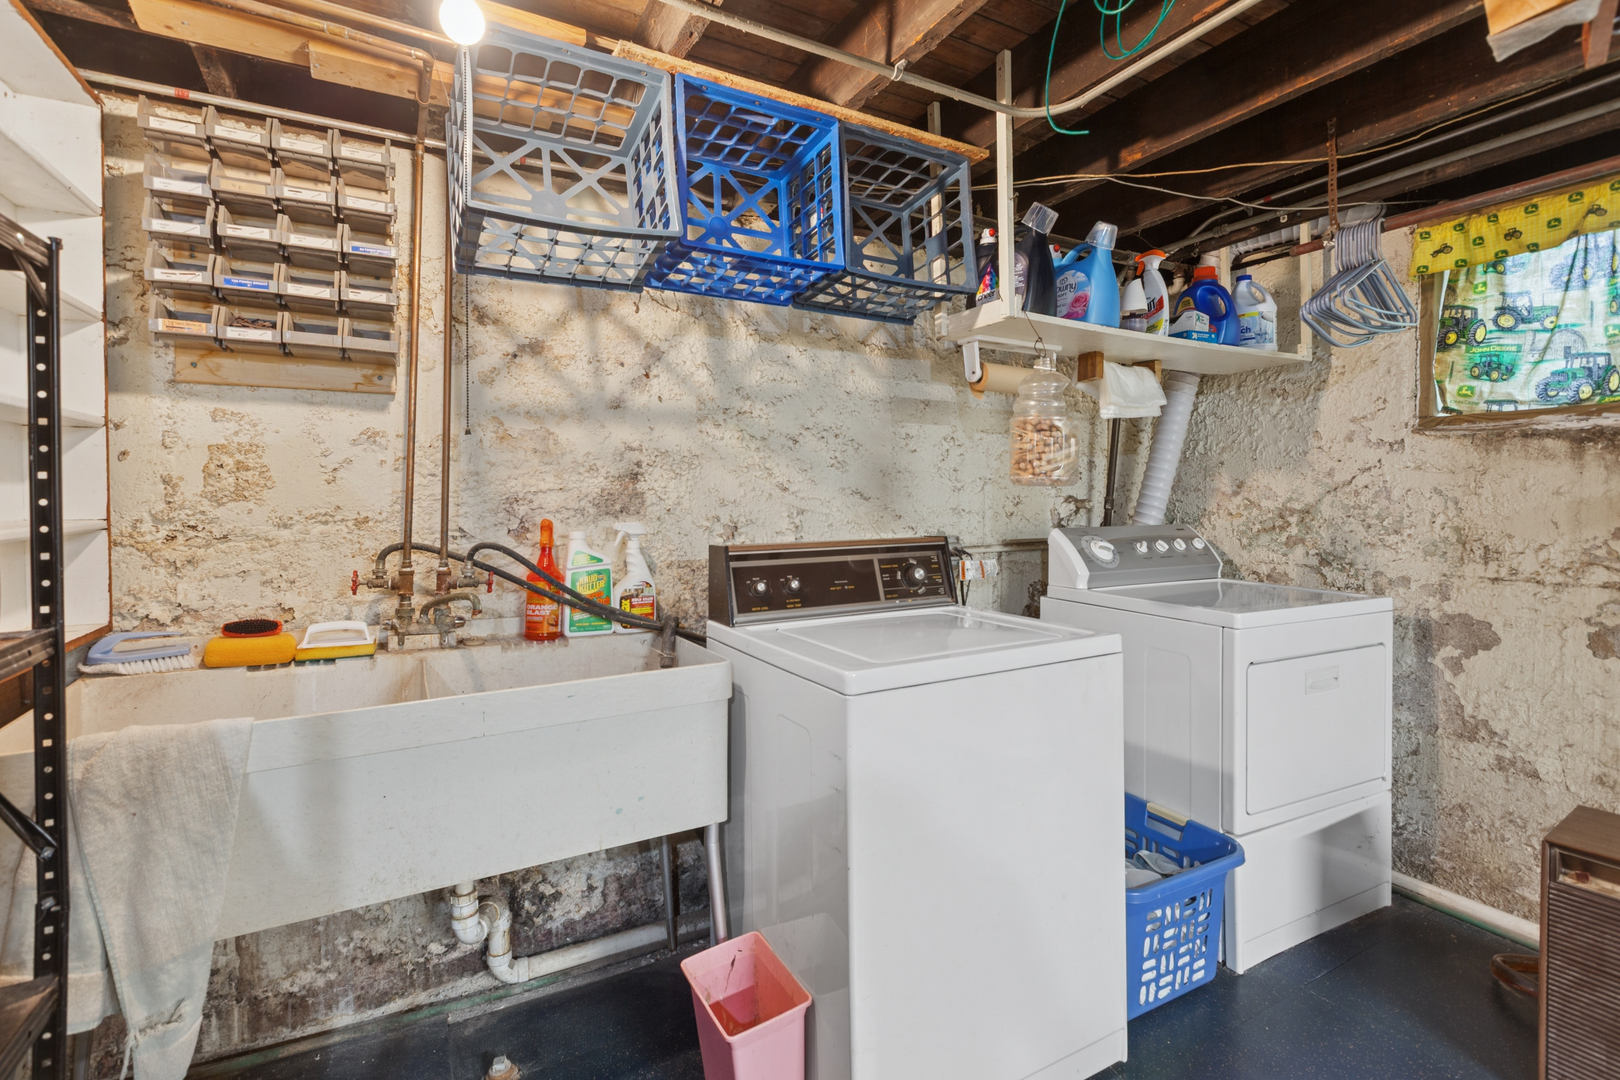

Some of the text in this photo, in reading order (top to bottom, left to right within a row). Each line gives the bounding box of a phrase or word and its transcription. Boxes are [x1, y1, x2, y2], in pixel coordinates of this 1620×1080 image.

[1057, 282, 1077, 293] owny
[579, 573, 598, 584] KRUD
[579, 580, 605, 593] KUTTER
